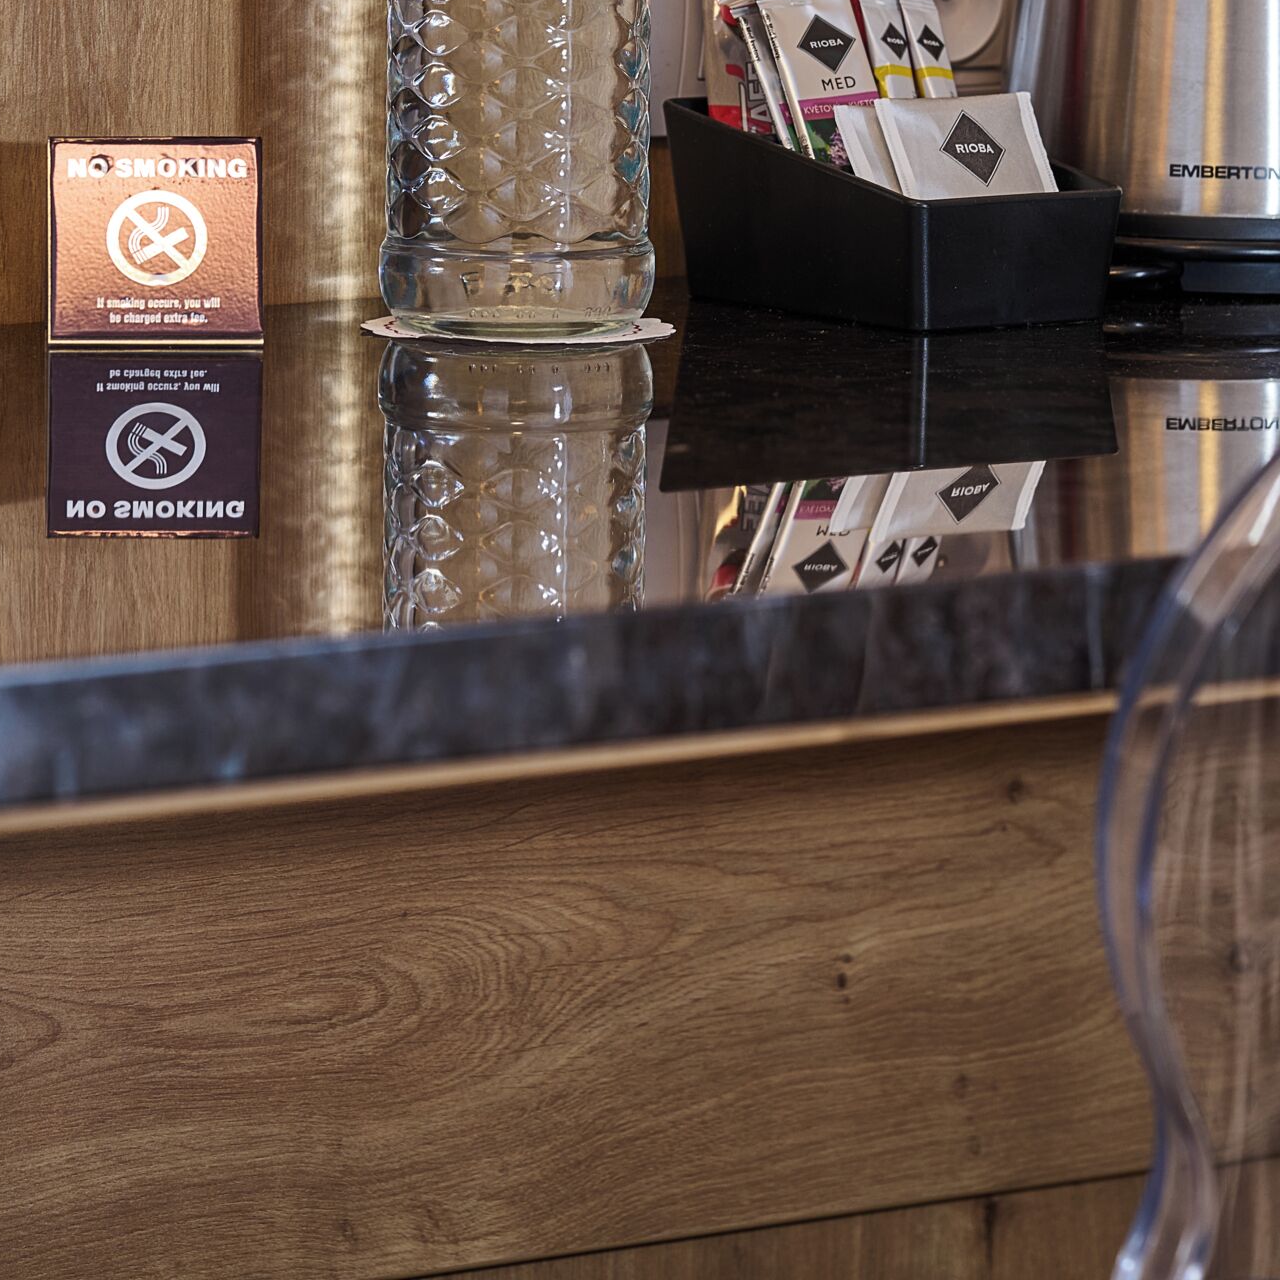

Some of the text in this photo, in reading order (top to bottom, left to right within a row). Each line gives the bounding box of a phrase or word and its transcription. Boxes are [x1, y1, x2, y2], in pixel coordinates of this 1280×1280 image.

[809, 36, 844, 50] RIOBA
[821, 76, 856, 91] MED
[954, 141, 995, 156] RIOBA
[67, 158, 248, 178] NO SMOKING
[96, 297, 221, 310] If smoking occurs, you will
[109, 312, 208, 325] be charged extra fee.
